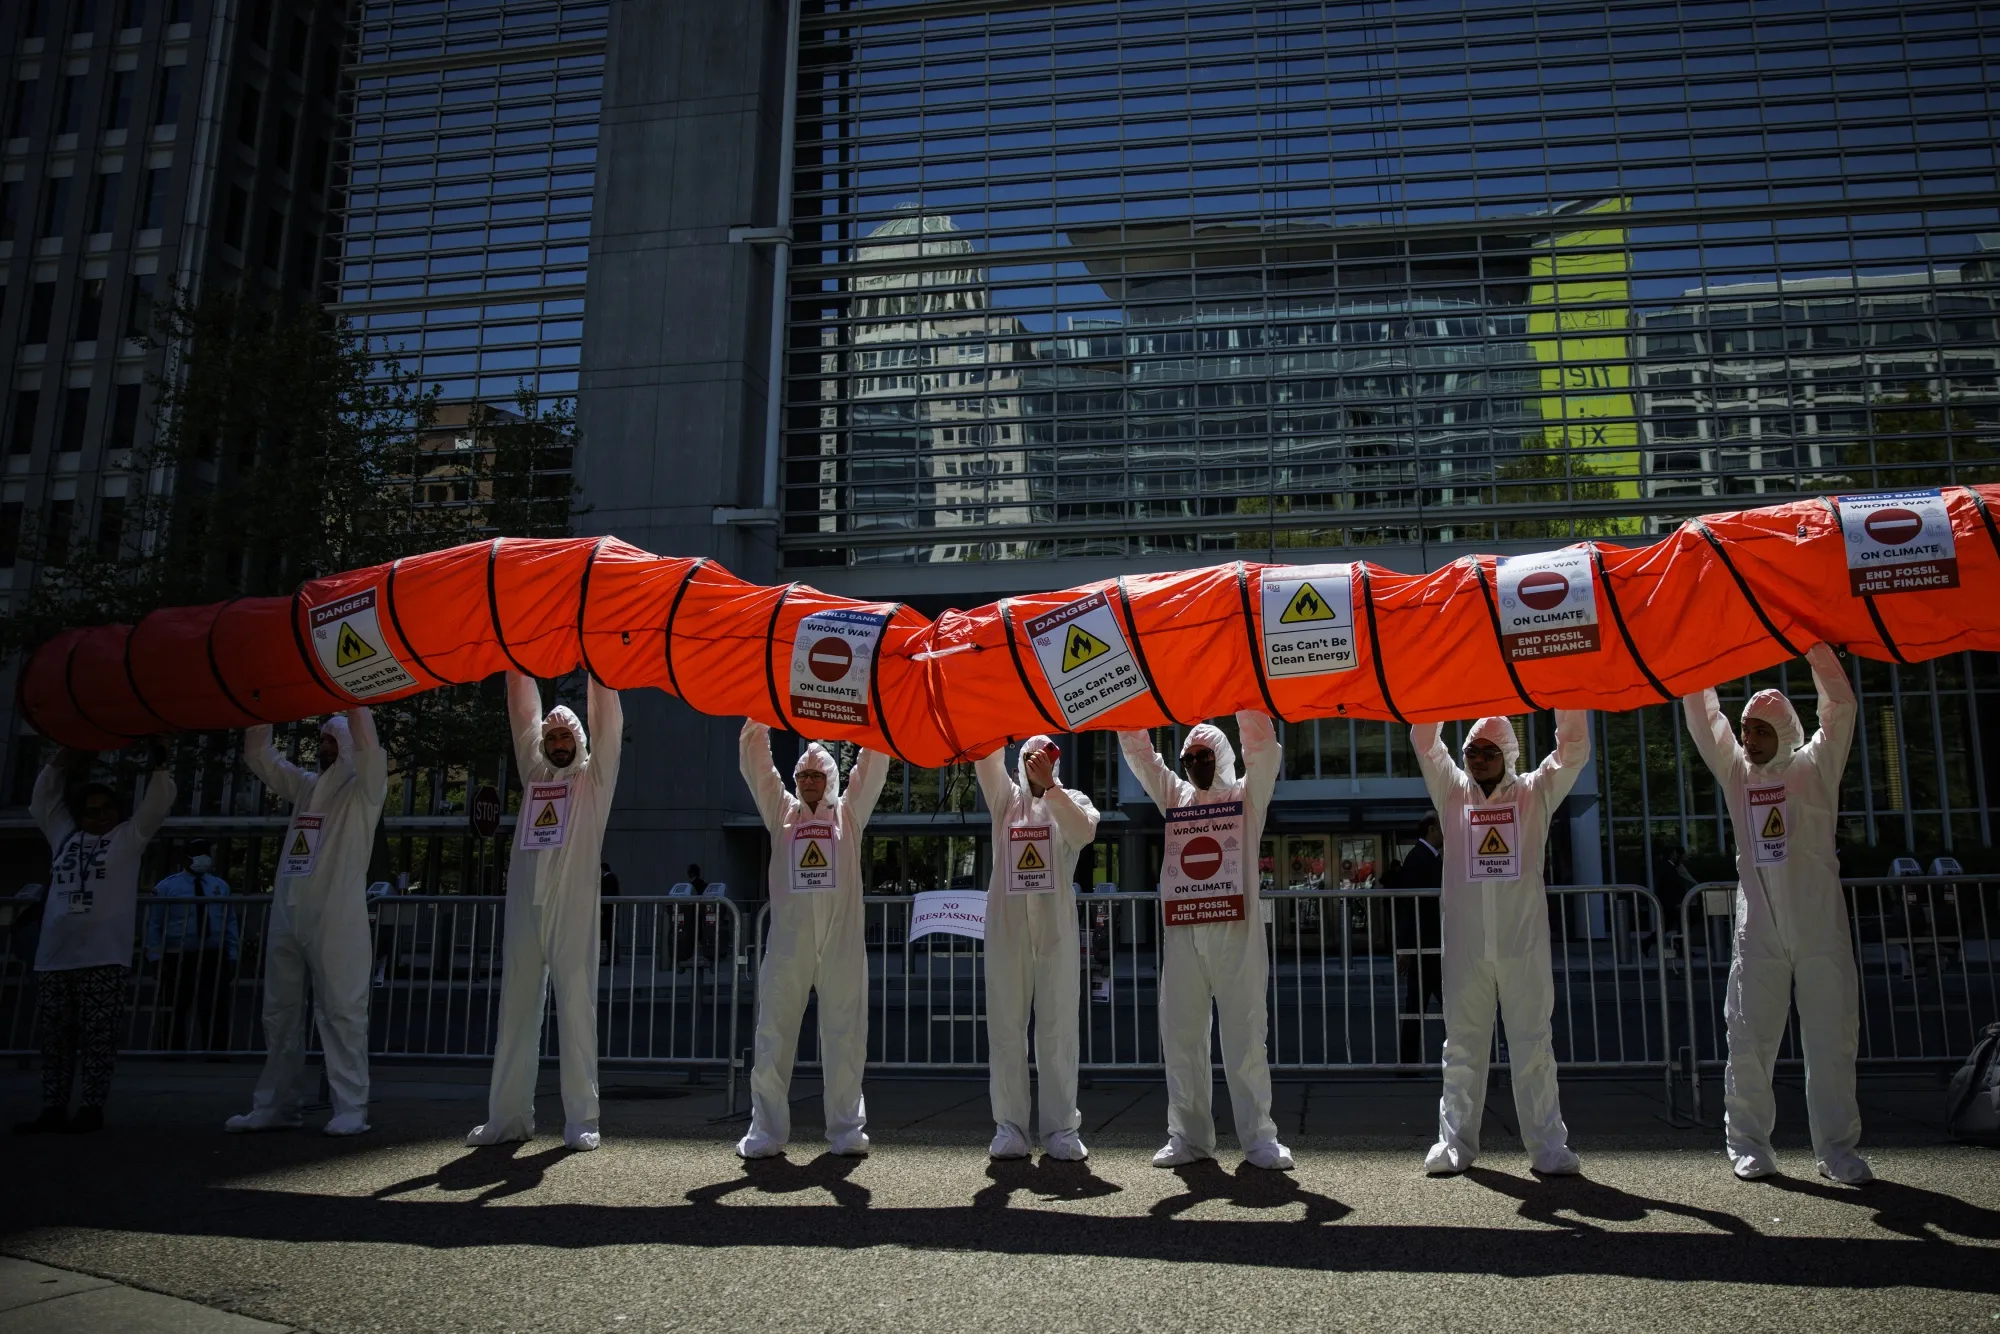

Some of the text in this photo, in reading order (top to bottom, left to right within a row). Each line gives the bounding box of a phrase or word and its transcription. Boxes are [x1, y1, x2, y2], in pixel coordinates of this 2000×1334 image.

[1850, 502, 1899, 510] WRONG
[1861, 544, 1939, 560] ON CLIMATE
[1553, 560, 1580, 569] WAY
[1866, 564, 1940, 580] END FOSSIL
[1858, 575, 1950, 592] FUEL FINANCE
[316, 596, 370, 622] DANGER
[1035, 597, 1099, 632] DANGER
[849, 613, 878, 623] BANK
[1513, 609, 1583, 626] ON CLIMATE
[807, 623, 871, 637] WRONG WAY
[1272, 637, 1347, 653] Gas Can't Be
[1518, 631, 1584, 646] END FOSSIL
[1512, 639, 1592, 658] FUEL FINANCE
[1272, 650, 1351, 666] Clean Energy
[344, 665, 398, 688] Gas Can't Be
[350, 672, 407, 694] Clean Energy
[1063, 664, 1131, 702] Gas Can't Be
[800, 682, 857, 697] ON CLIMATE
[1067, 673, 1138, 714] Clean Energy
[802, 700, 856, 714] END FOSSIL
[797, 707, 863, 722] FUEL FINANCE
[541, 788, 566, 798] DANGER
[475, 801, 500, 822] STOP
[1172, 805, 1236, 818] WORLD BANK
[1480, 812, 1512, 822] DANGER
[534, 829, 557, 837] Natural
[804, 828, 830, 837] DANGER
[1018, 829, 1048, 838] DANGER
[1173, 823, 1234, 835] WRONG WAY
[800, 871, 828, 879] Natural
[1018, 873, 1046, 881] Natural
[1174, 881, 1232, 894] ON CLIMATE
[941, 902, 959, 910] NO
[1177, 900, 1231, 912] END FOSSIL
[1171, 908, 1238, 921] FUEL FINANCE
